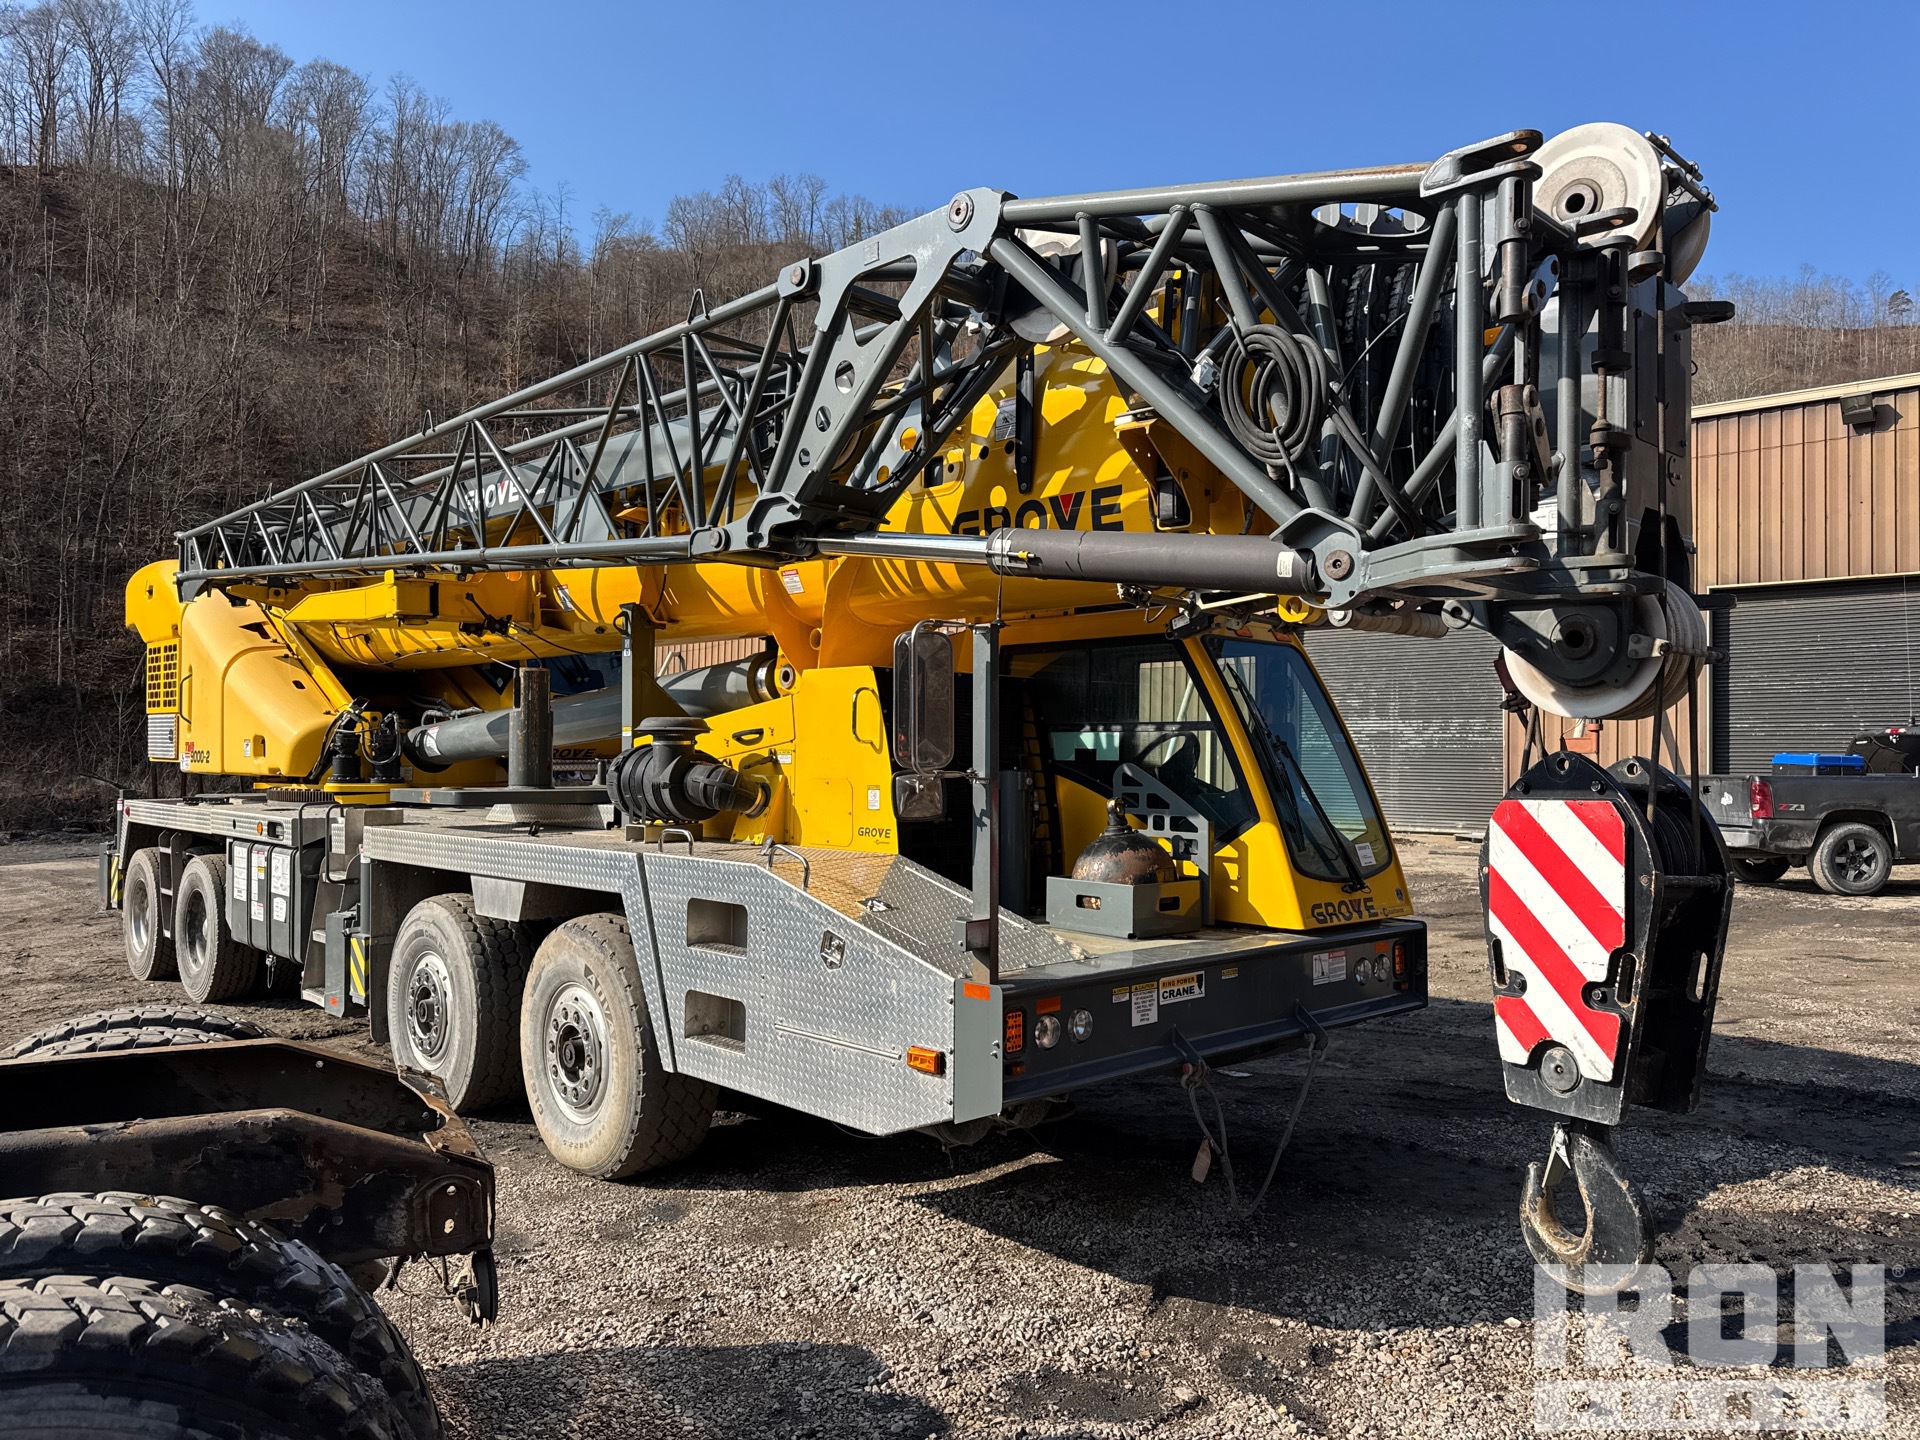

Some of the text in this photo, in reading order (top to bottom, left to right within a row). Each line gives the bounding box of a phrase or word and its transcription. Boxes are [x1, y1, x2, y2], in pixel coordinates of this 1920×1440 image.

[552, 748, 597, 758] ROVE
[1778, 803, 1805, 812] Z71
[858, 827, 891, 838] GROVE
[1311, 897, 1378, 925] GROVE
[1162, 986, 1195, 1000] CRANE
